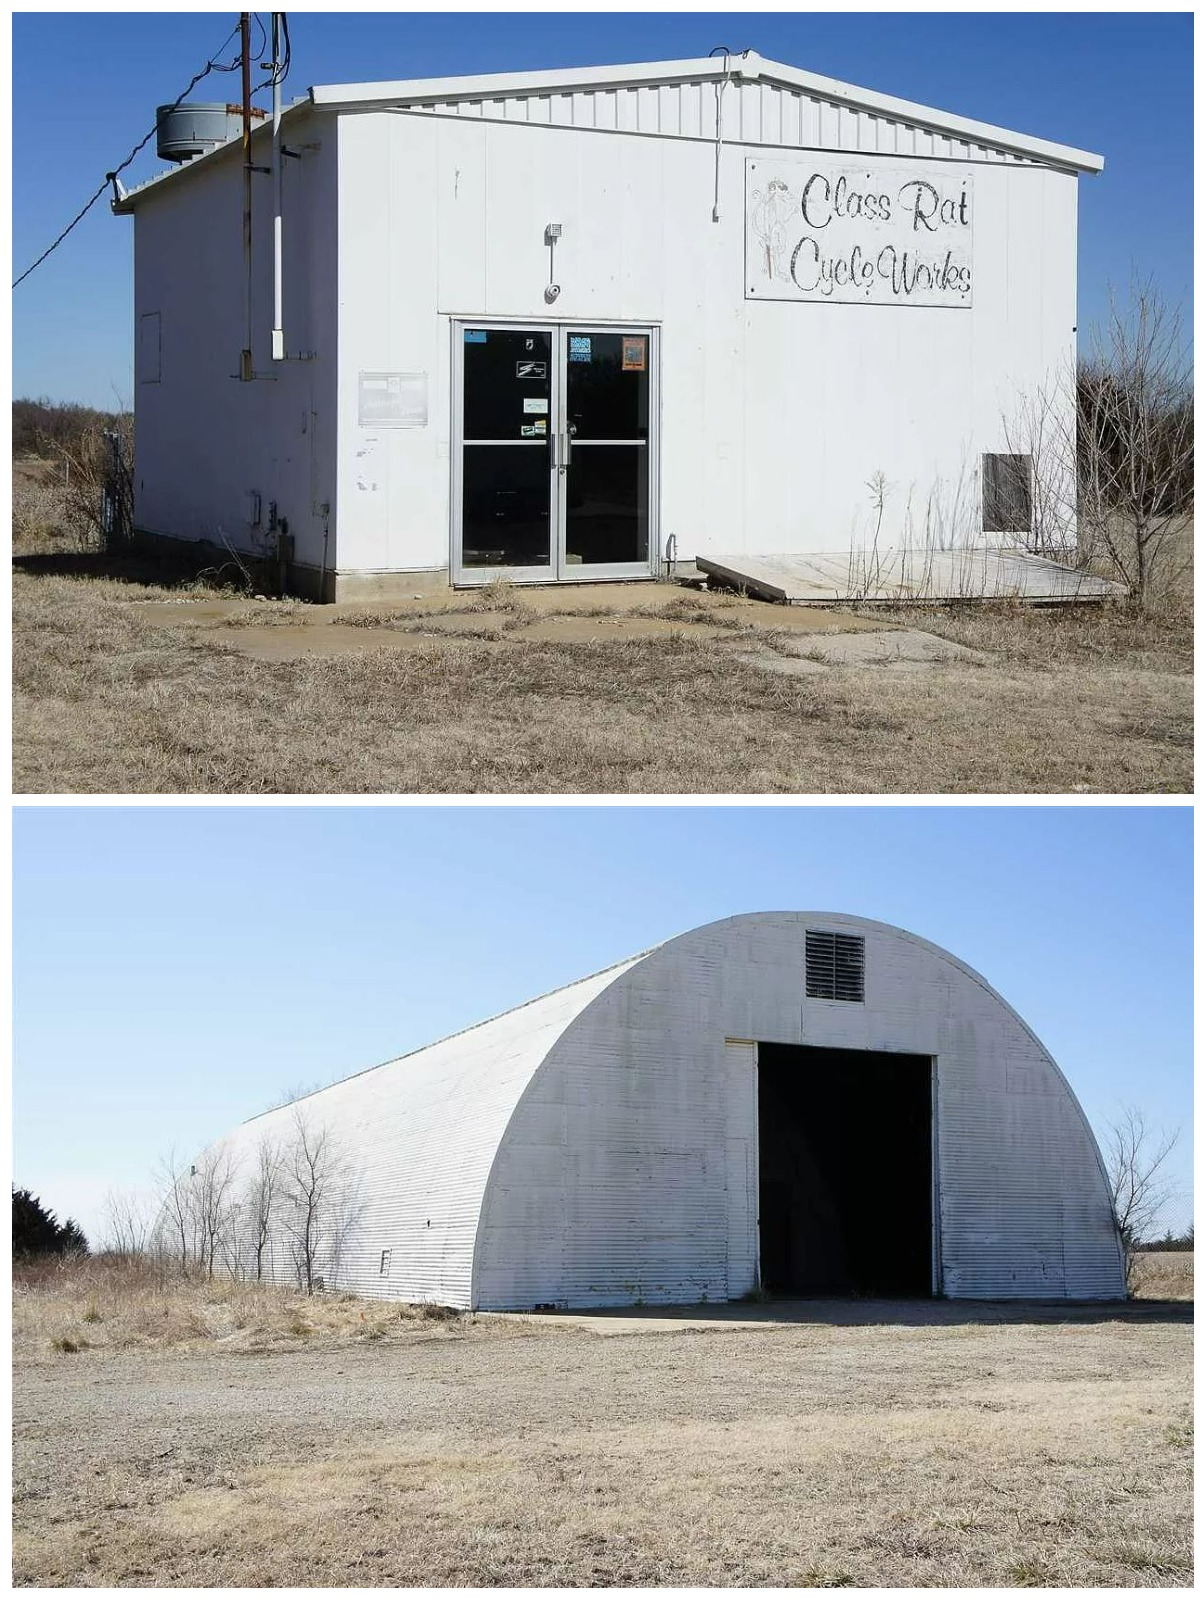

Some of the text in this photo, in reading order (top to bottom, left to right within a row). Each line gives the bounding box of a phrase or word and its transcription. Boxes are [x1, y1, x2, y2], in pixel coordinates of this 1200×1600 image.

[802, 173, 968, 232] Class Rat
[877, 245, 971, 295] Works
